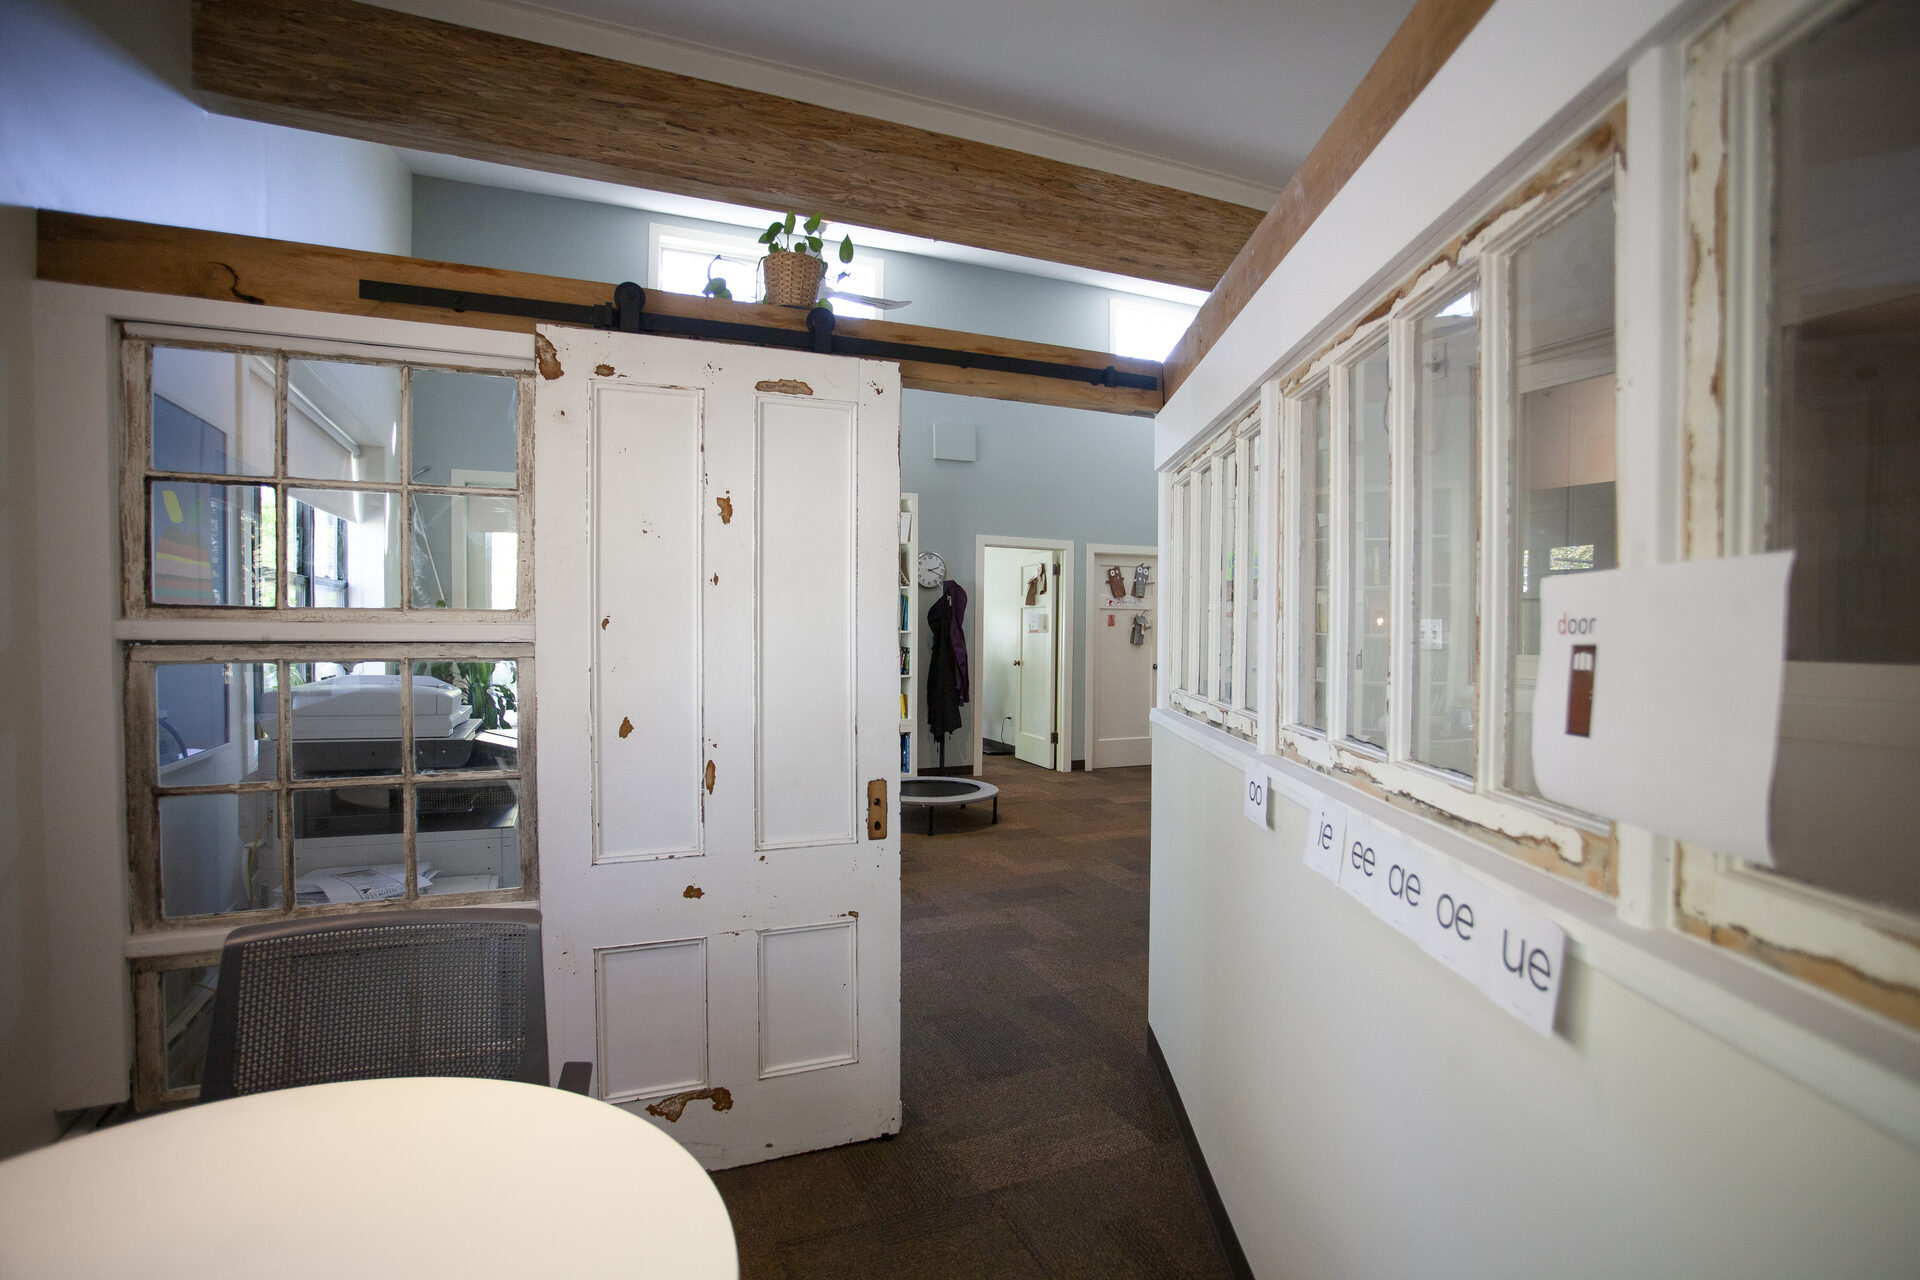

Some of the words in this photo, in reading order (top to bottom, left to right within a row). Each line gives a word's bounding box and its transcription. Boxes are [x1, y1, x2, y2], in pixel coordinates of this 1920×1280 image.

[1557, 611, 1597, 635] door
[1249, 780, 1262, 806] oo
[1318, 811, 1333, 850] ie
[1352, 841, 1375, 876] ee
[1389, 864, 1421, 906] ae
[1437, 893, 1474, 941] oe
[1503, 929, 1551, 992] ue
